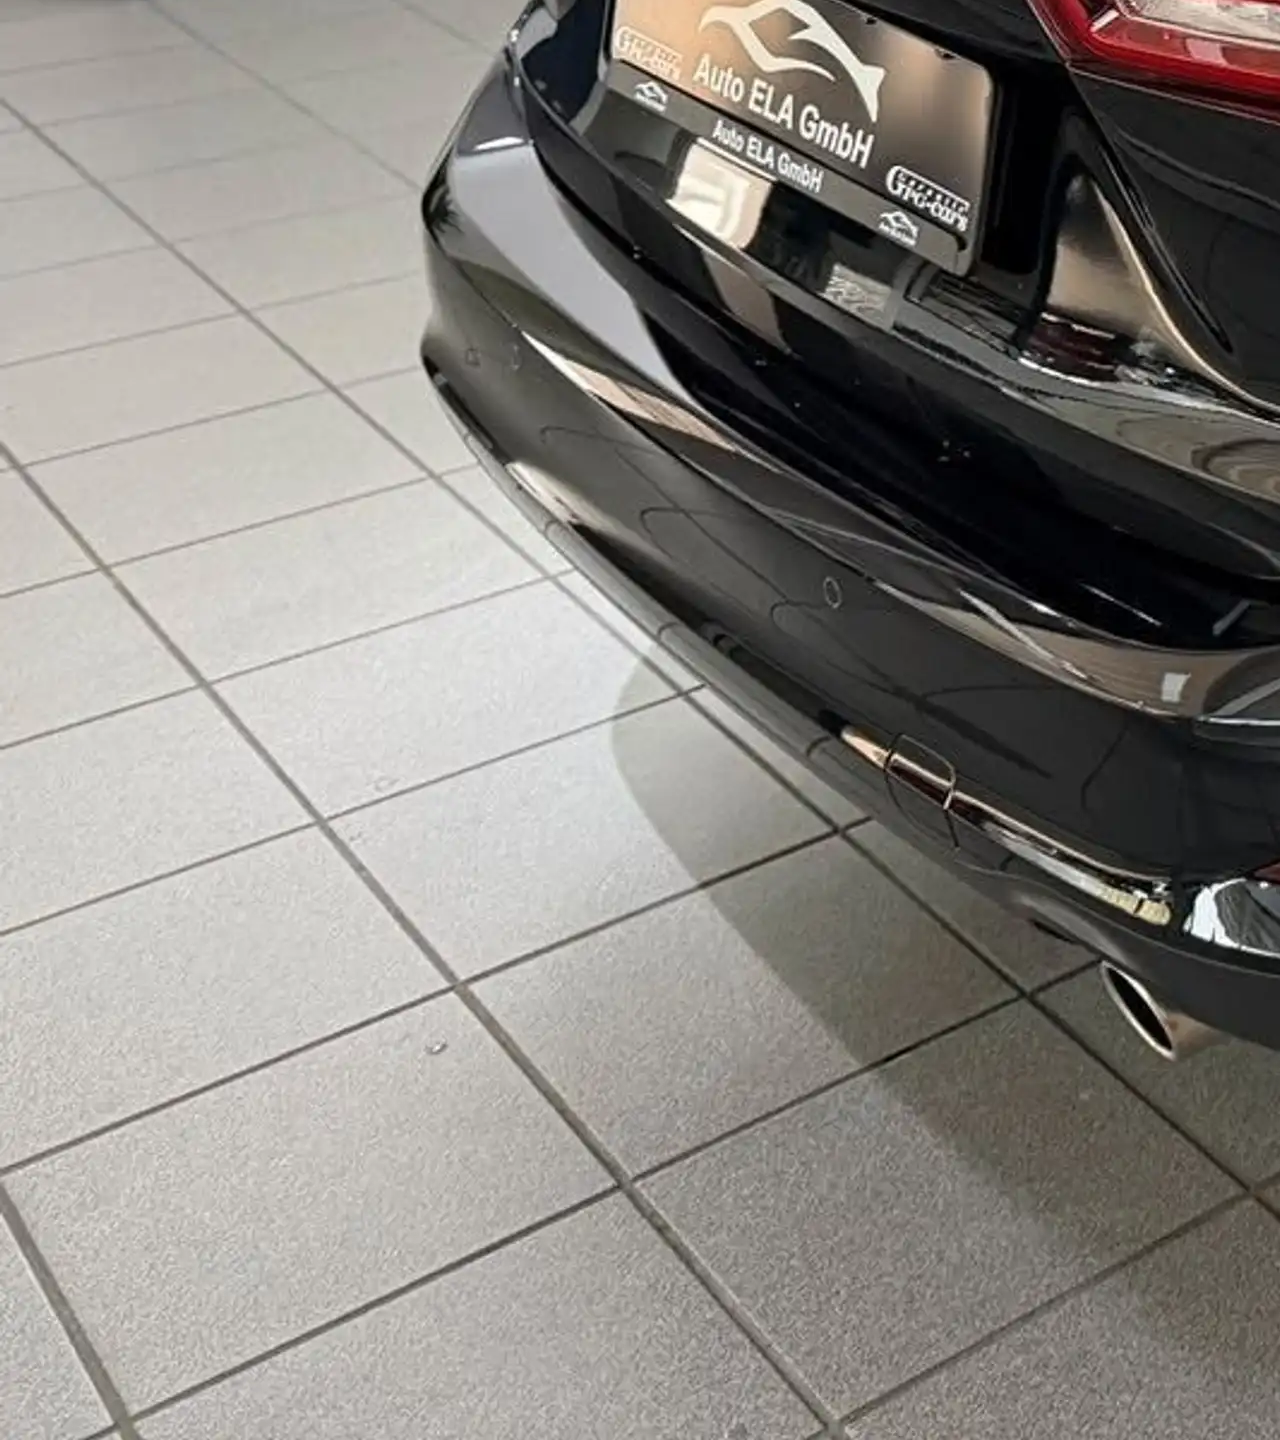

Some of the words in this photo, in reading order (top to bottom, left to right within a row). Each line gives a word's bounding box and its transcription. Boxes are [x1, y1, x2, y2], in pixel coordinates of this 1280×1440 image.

[692, 53, 745, 103] Auto
[748, 77, 794, 130] ELA
[800, 103, 875, 169] GmbH
[712, 119, 745, 152] Auto
[746, 135, 775, 171] ELA
[777, 152, 824, 194] GmbH
